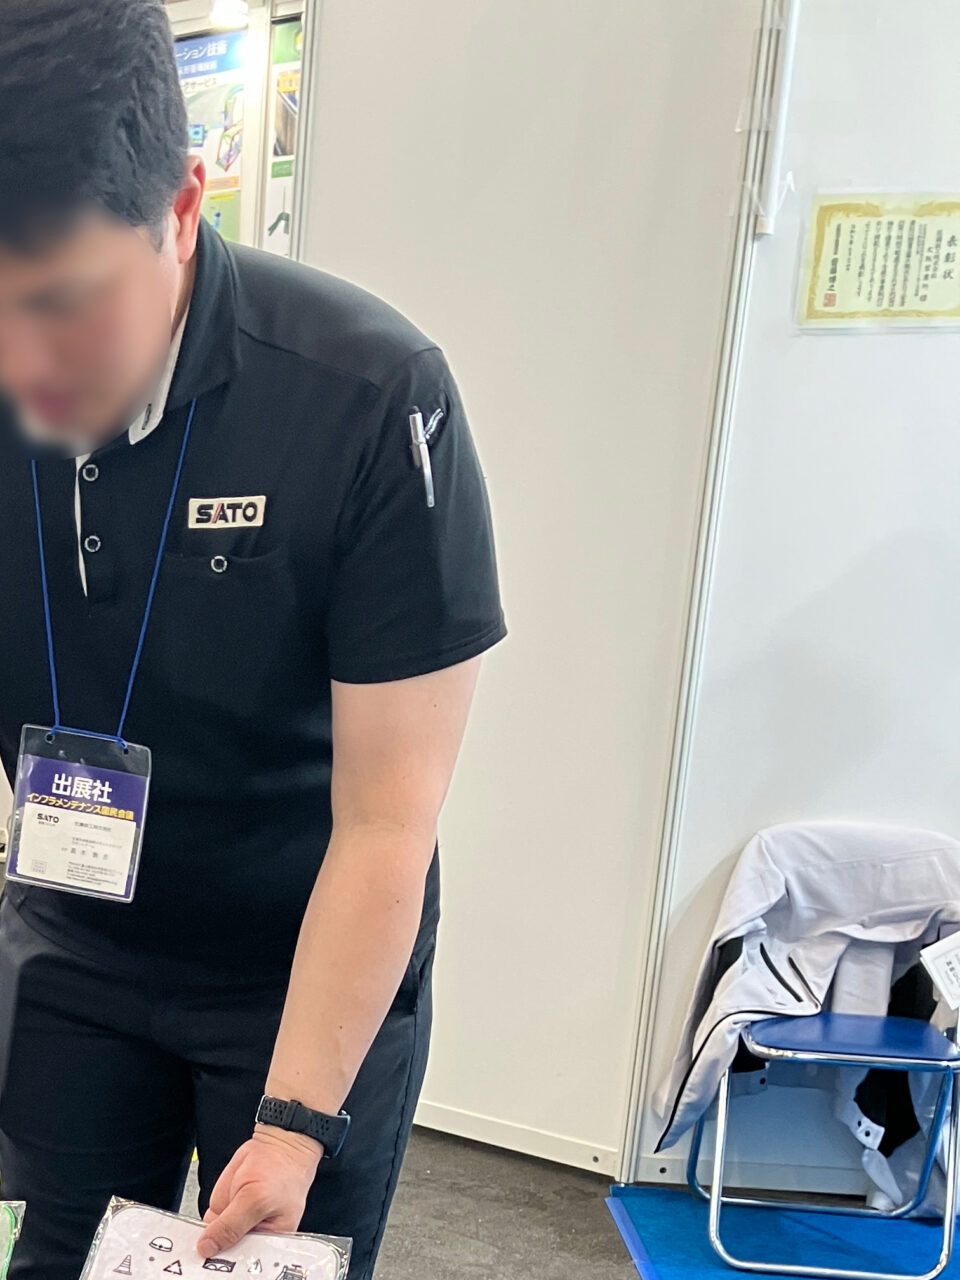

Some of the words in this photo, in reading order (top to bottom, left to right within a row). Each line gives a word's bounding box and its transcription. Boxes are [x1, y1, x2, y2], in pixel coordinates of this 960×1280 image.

[196, 502, 257, 523] SATO
[52, 773, 113, 803] 出展社
[37, 813, 59, 823] SATO
